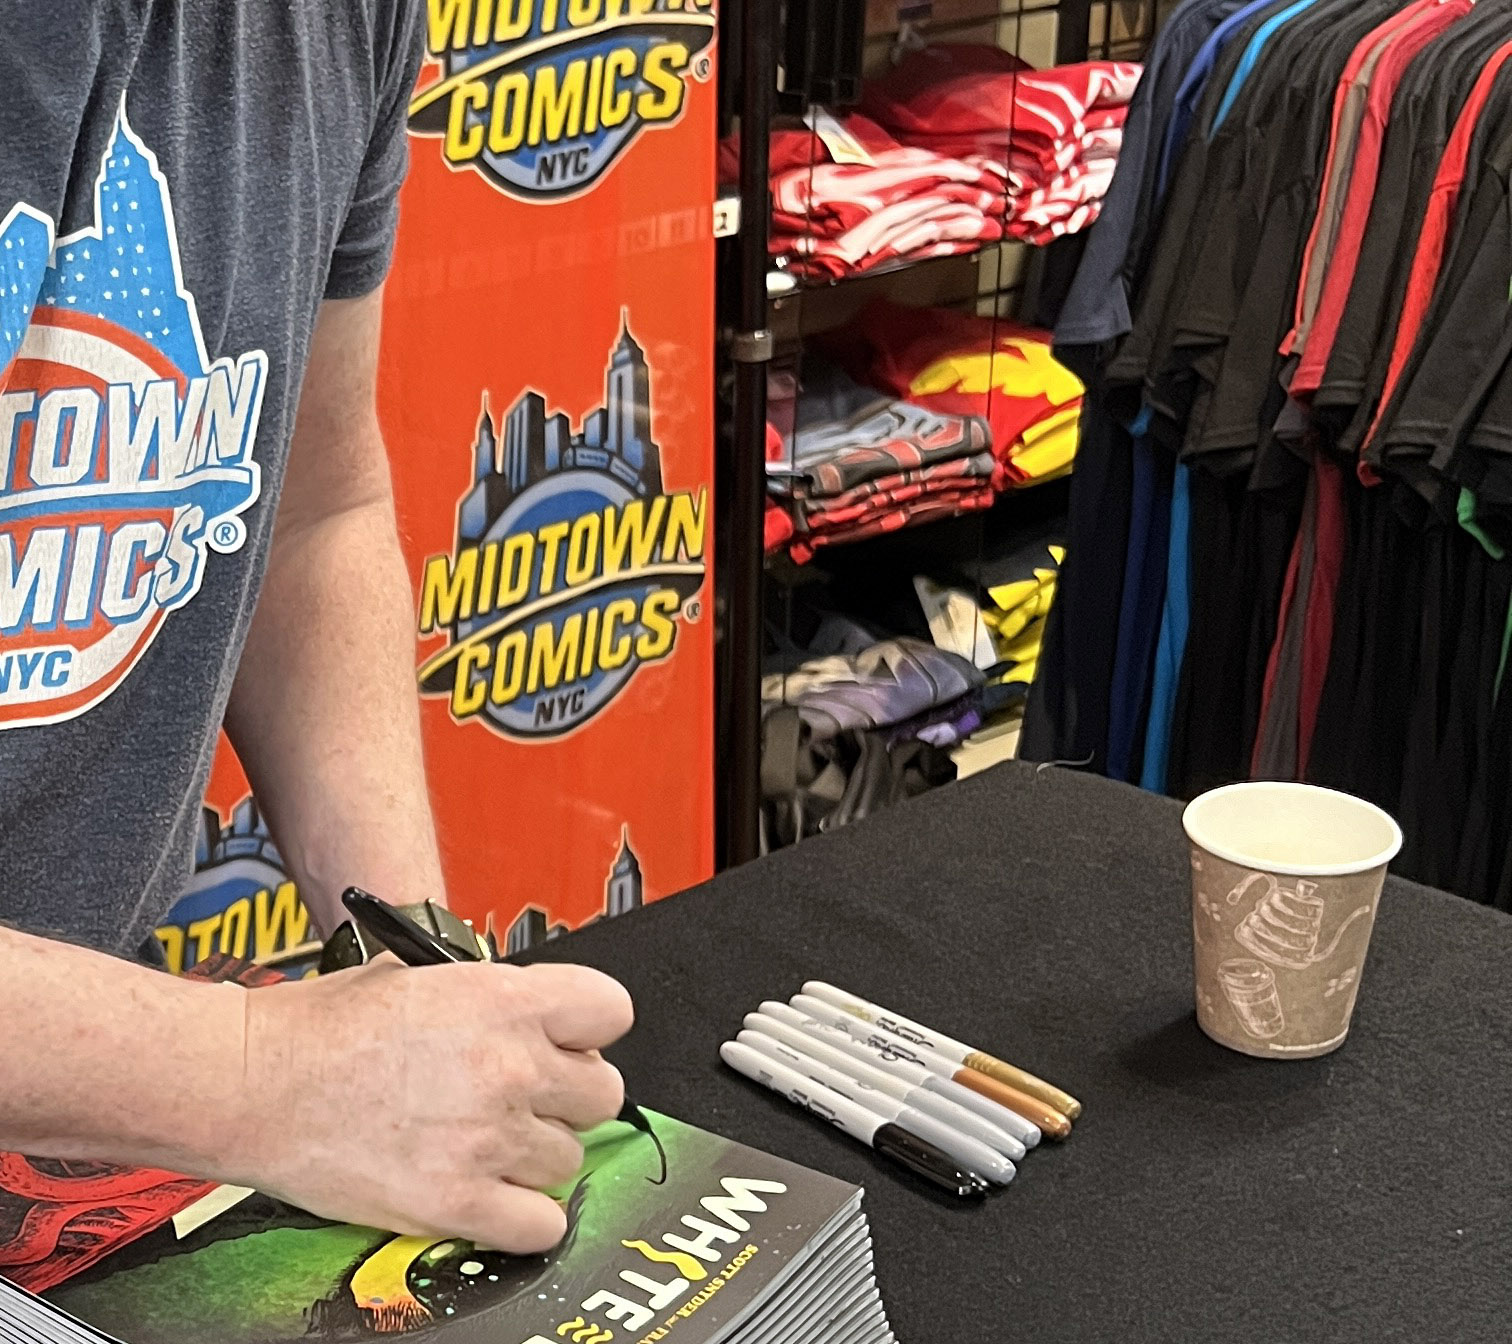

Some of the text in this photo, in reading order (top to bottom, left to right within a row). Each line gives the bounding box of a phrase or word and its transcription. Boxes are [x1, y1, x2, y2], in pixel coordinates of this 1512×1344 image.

[444, 42, 689, 162] COMICS
[536, 147, 589, 186] NYC
[419, 487, 707, 632] MIDTOWN
[451, 589, 680, 718] COMICS
[534, 688, 585, 727] NYC
[720, 1244, 758, 1280] SCOTT
